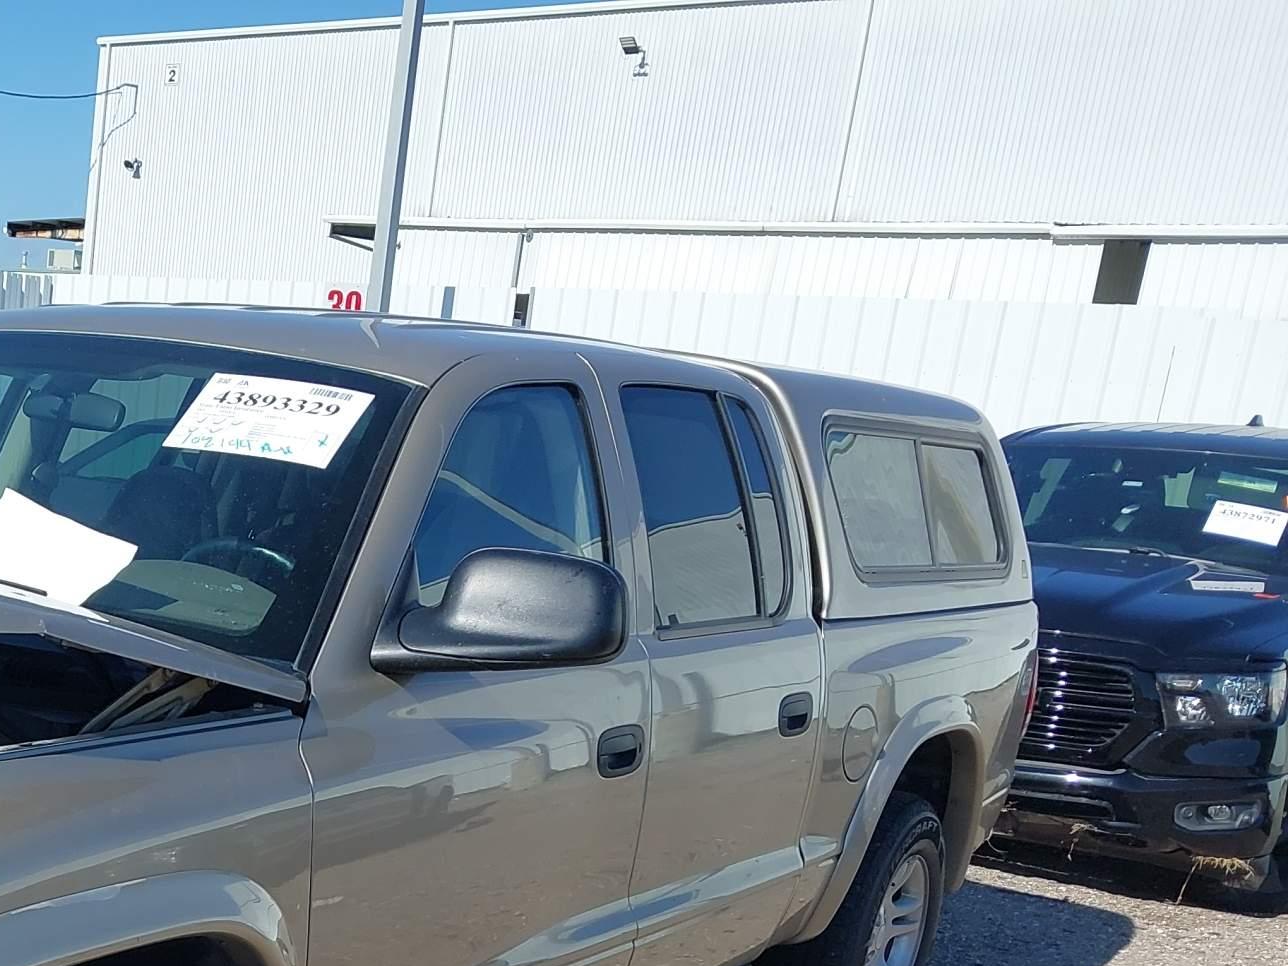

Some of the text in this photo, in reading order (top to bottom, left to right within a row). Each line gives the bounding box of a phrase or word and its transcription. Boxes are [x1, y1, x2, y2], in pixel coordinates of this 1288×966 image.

[168, 70, 176, 82] 2
[327, 289, 362, 311] 30
[213, 390, 341, 417] 43893329
